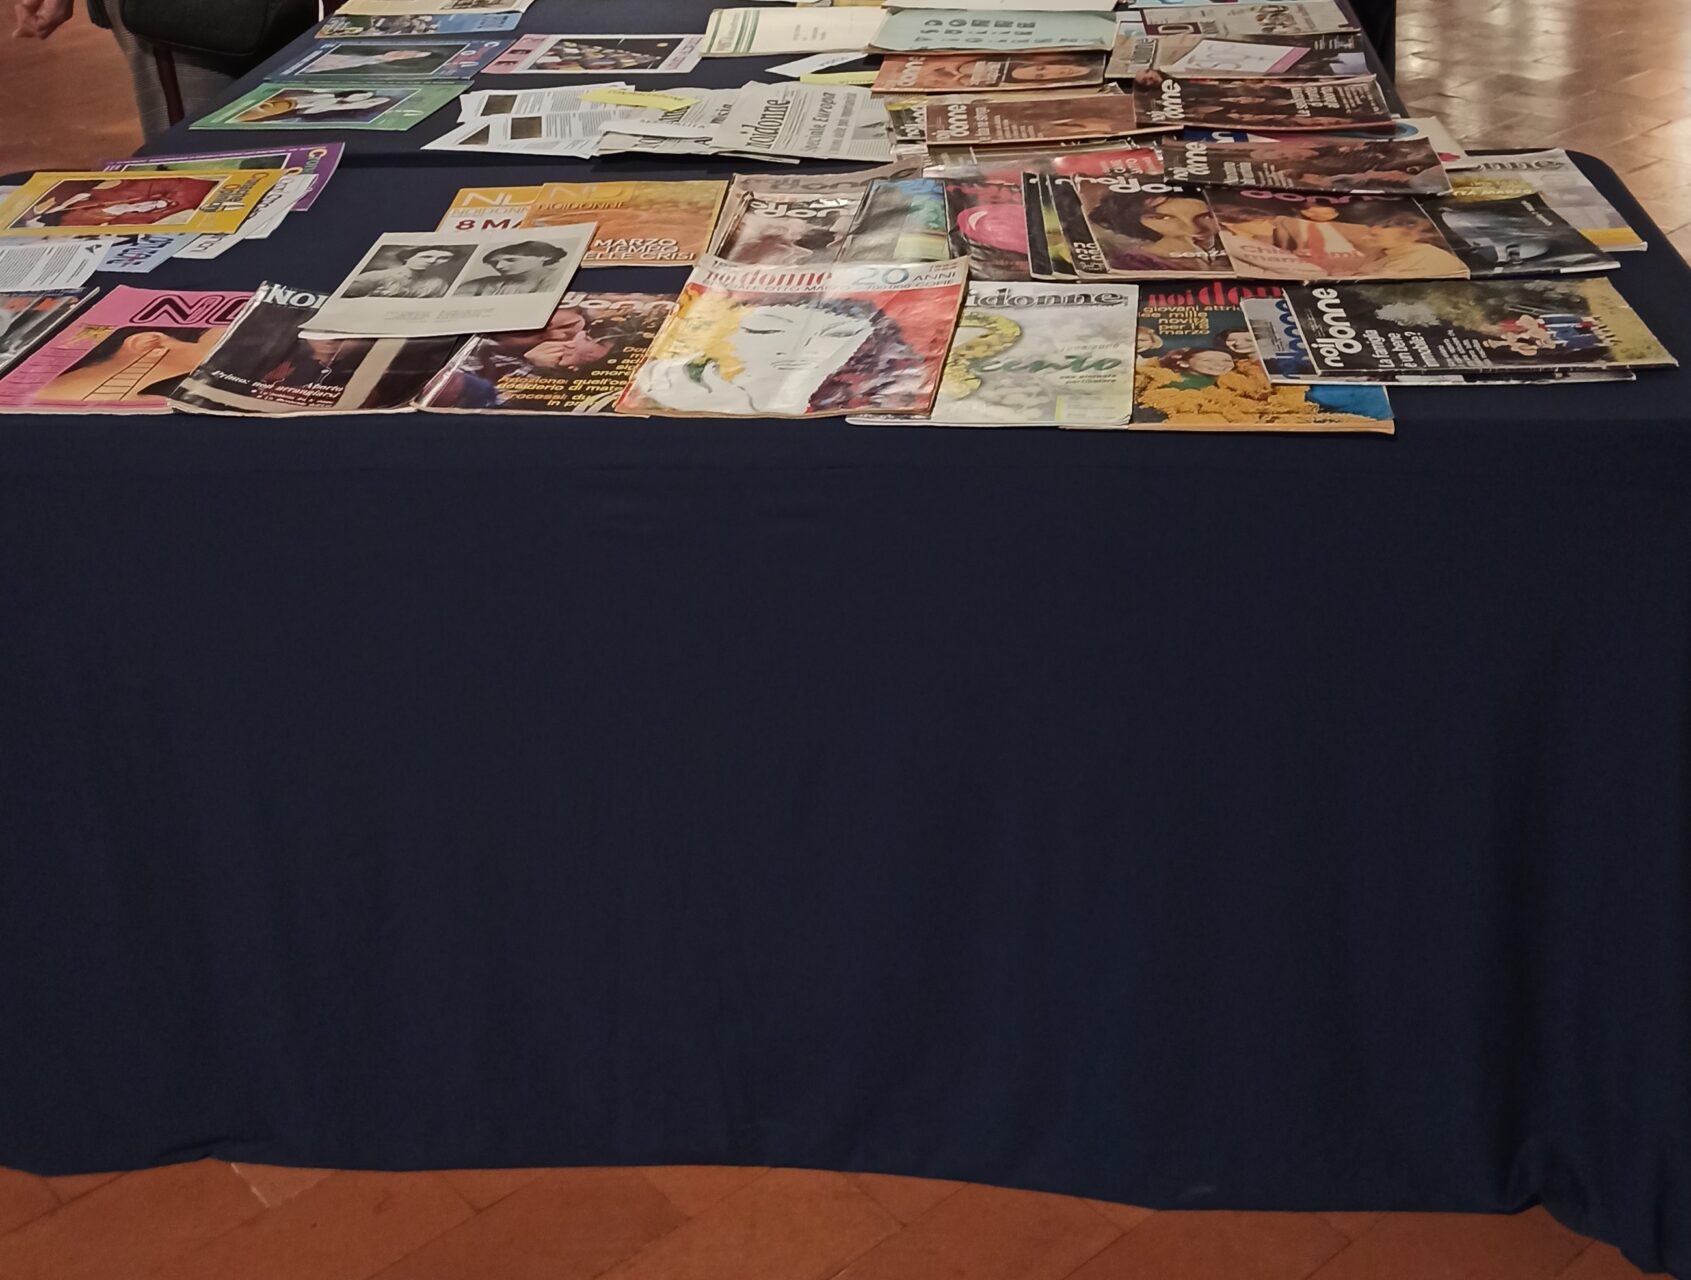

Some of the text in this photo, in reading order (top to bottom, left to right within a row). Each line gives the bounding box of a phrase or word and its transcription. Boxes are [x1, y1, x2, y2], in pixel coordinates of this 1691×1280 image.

[455, 220, 477, 231] 8
[594, 238, 679, 248] MARZO
[604, 245, 680, 255] TEMPO
[639, 252, 697, 261] CRISI
[912, 270, 957, 282] ANNI
[968, 287, 1124, 309] idonne
[1143, 305, 1200, 313] giovani
[1311, 287, 1363, 368] noi donne
[1364, 329, 1396, 368] La famiglia
[1387, 332, 1408, 353] bene
[1403, 331, 1440, 368] immobile?
[211, 370, 251, 385] Primo:
[276, 384, 341, 400] arrangiarsi
[301, 381, 345, 392] Aborto
[567, 383, 583, 392] di
[585, 383, 624, 392] mate
